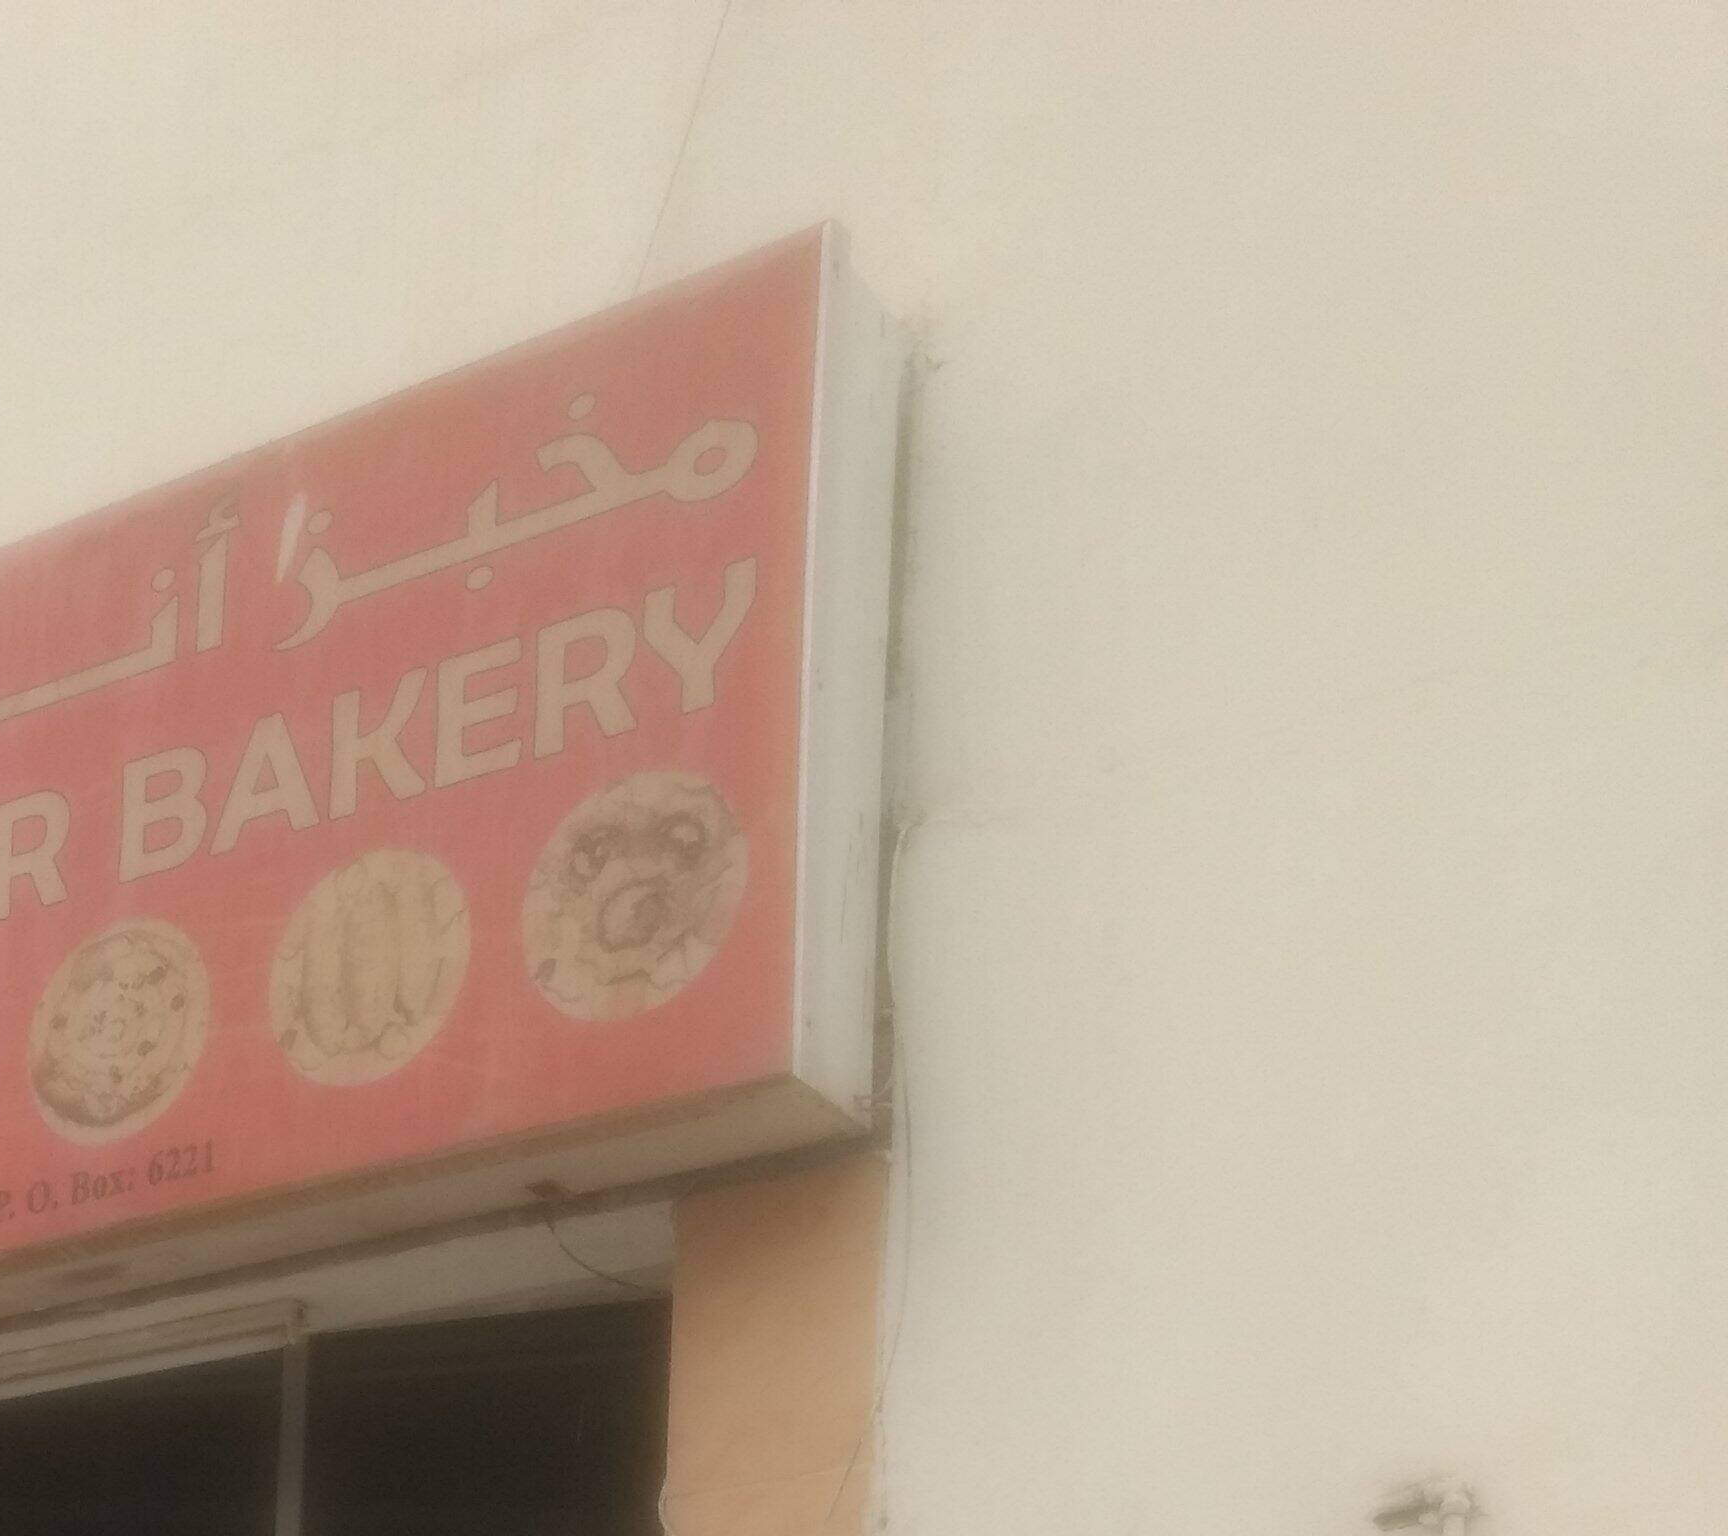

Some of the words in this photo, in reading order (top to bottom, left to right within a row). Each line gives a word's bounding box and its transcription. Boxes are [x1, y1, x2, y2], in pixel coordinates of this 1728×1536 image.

[116, 556, 758, 886] BAKERY
[69, 1167, 136, 1206] Box:
[146, 1138, 215, 1187] 6221
